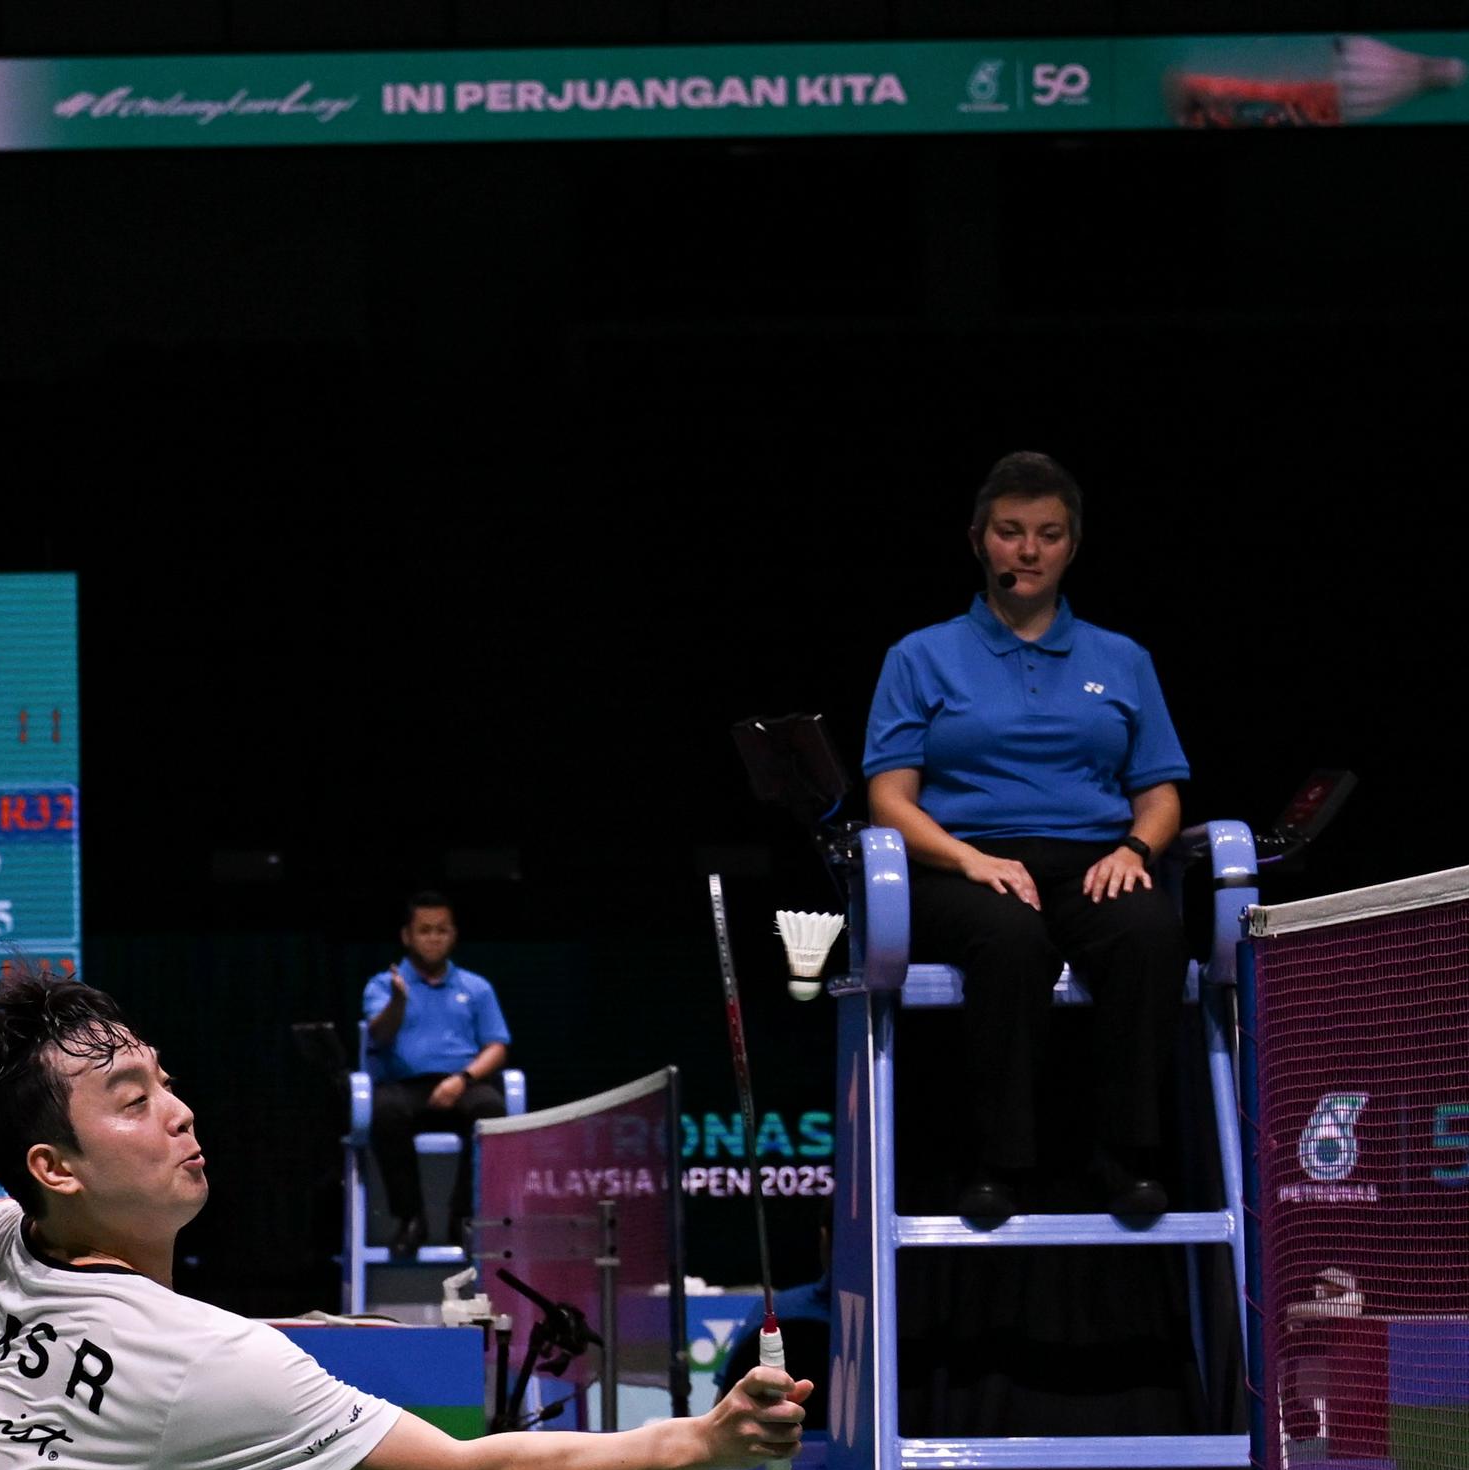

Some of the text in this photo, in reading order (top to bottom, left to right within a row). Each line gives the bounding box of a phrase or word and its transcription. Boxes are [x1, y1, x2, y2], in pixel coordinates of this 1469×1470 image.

[382, 82, 446, 114] INI
[455, 76, 788, 113] PERJUANGAN
[797, 73, 907, 106] KITA
[1032, 63, 1090, 106] 50
[0, 794, 74, 831] R32
[759, 1165, 835, 1197] 2025
[18, 1322, 58, 1379] S
[65, 1338, 114, 1416] R
